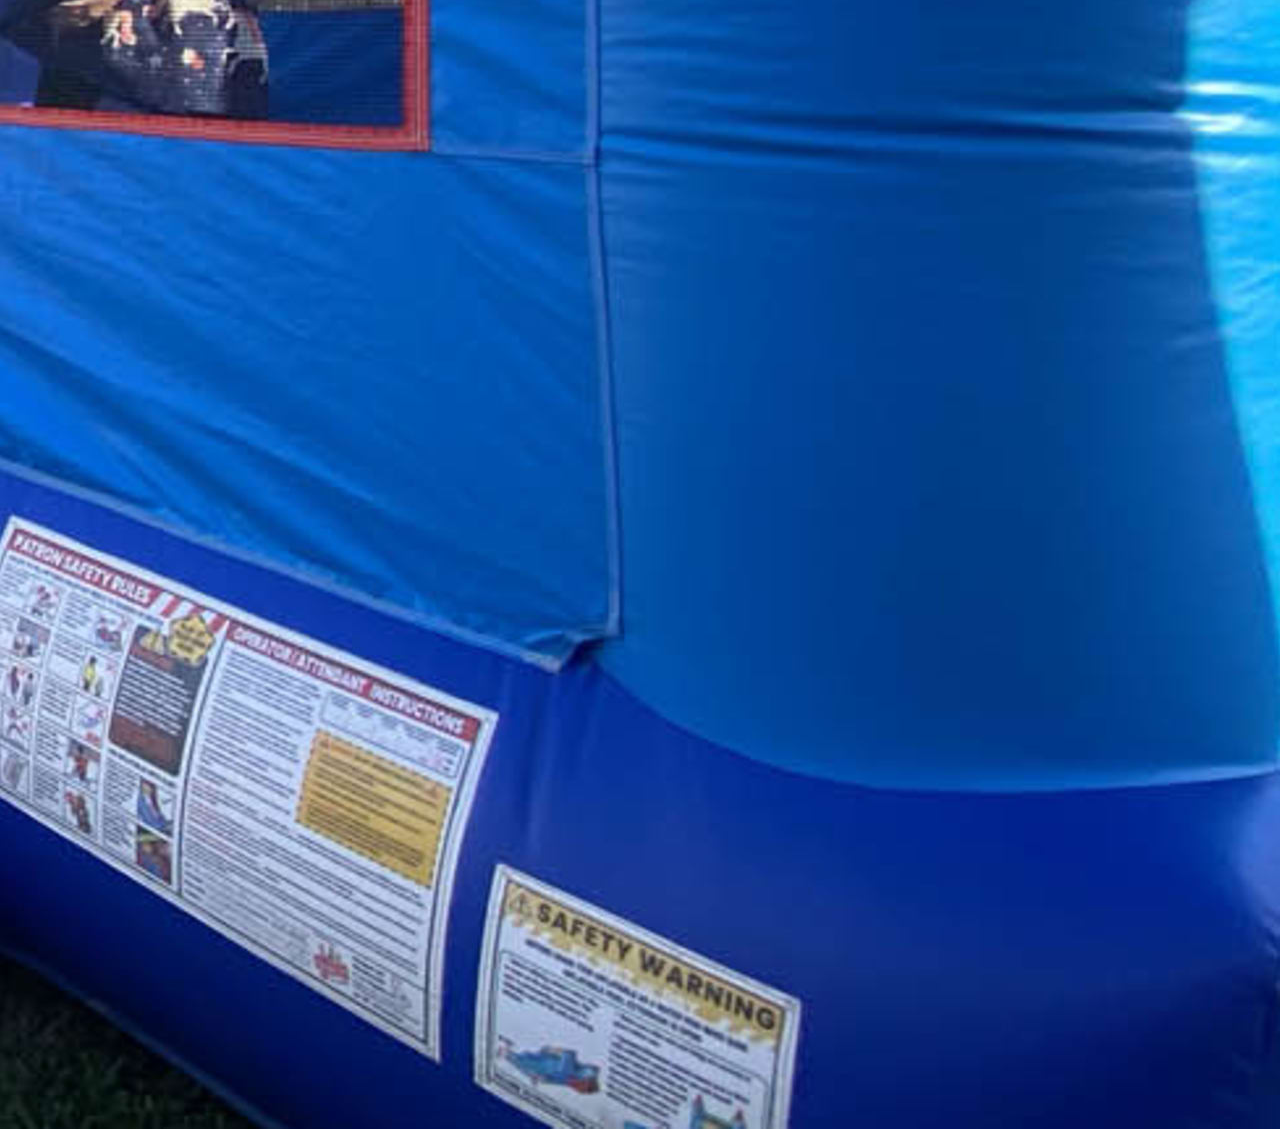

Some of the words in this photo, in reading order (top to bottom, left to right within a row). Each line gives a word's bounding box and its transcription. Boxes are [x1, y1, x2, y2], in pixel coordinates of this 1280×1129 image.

[13, 534, 62, 566] PATRON
[63, 555, 111, 587] SAFETY
[111, 576, 151, 604] RULES
[370, 681, 465, 736] INSTRUCTIONS
[536, 902, 632, 962] SAFETY
[640, 948, 777, 1031] WARNING
